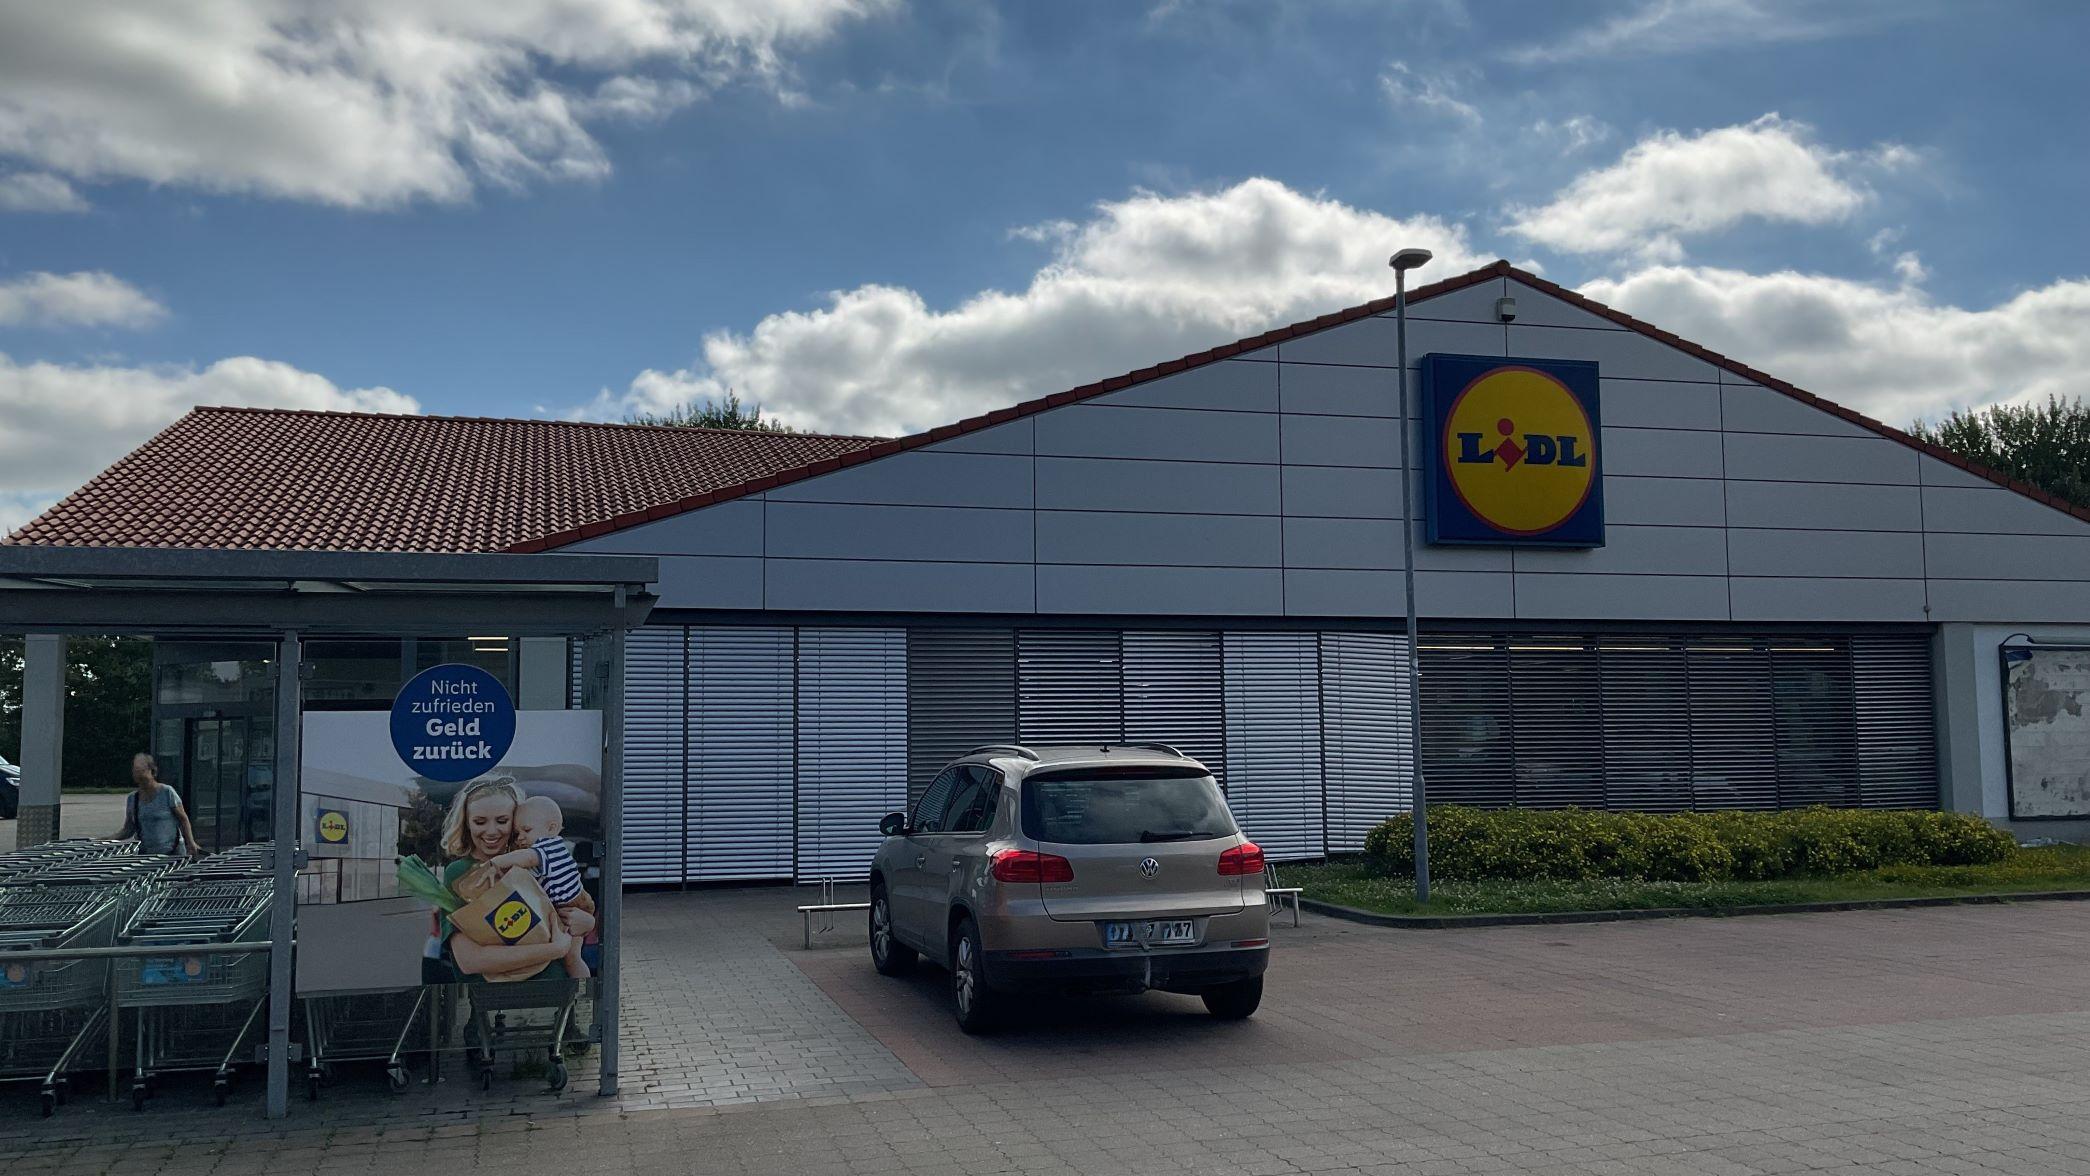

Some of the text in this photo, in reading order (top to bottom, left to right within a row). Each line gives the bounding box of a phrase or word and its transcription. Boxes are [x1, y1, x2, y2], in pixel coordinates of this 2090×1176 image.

[431, 680, 478, 695] Nicht
[411, 698, 495, 713] zufrieden
[426, 718, 481, 736] Geld
[413, 741, 492, 760] zurück
